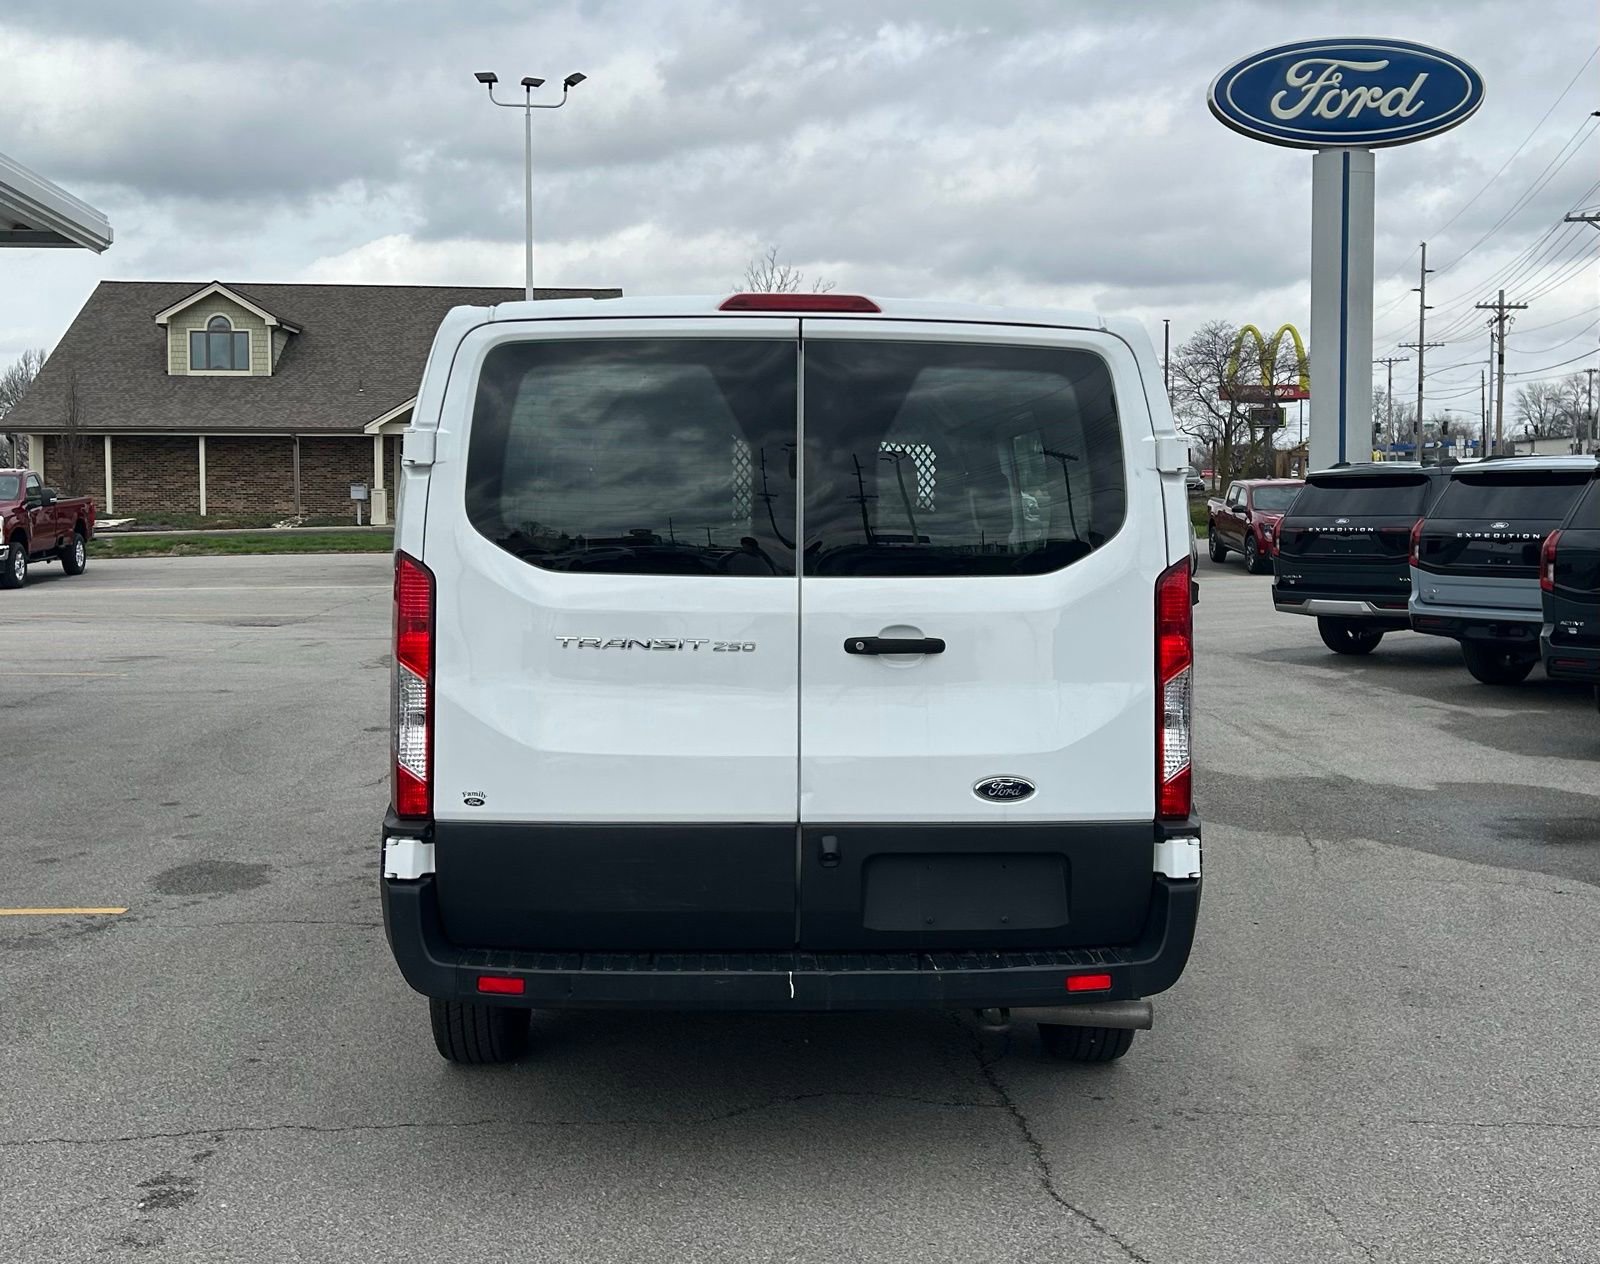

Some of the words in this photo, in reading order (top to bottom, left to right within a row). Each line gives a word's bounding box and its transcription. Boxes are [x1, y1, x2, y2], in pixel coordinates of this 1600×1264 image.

[1270, 58, 1430, 120] Ford
[555, 635, 709, 651] TRANSIT
[712, 641, 756, 652] 250
[462, 791, 487, 799] Family
[988, 781, 1021, 796] Ford
